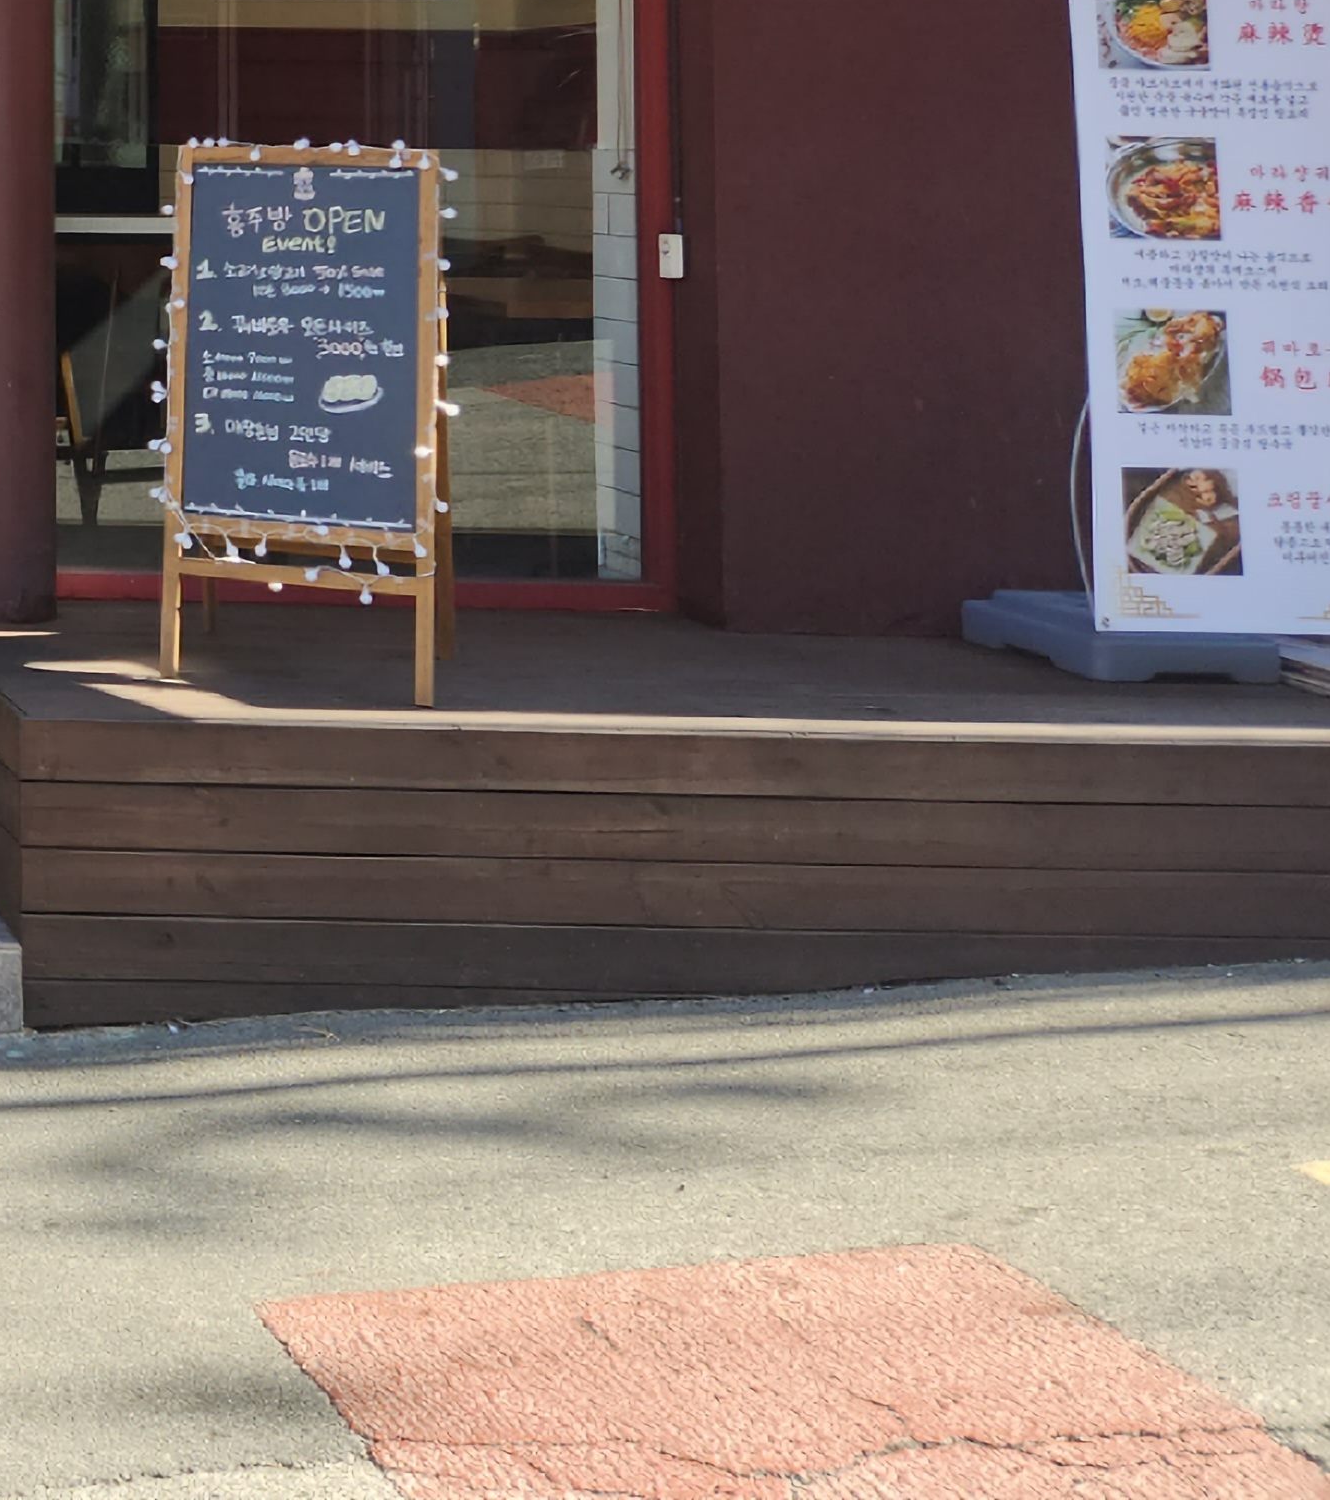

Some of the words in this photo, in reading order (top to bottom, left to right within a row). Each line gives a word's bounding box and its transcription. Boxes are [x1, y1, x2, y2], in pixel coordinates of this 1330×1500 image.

[1231, 189, 1330, 215] 麻辣香
[221, 202, 293, 238] 홍주방
[302, 206, 386, 234] OPEN
[1261, 340, 1330, 357] 꿔바로
[1259, 365, 1330, 391] 锅包
